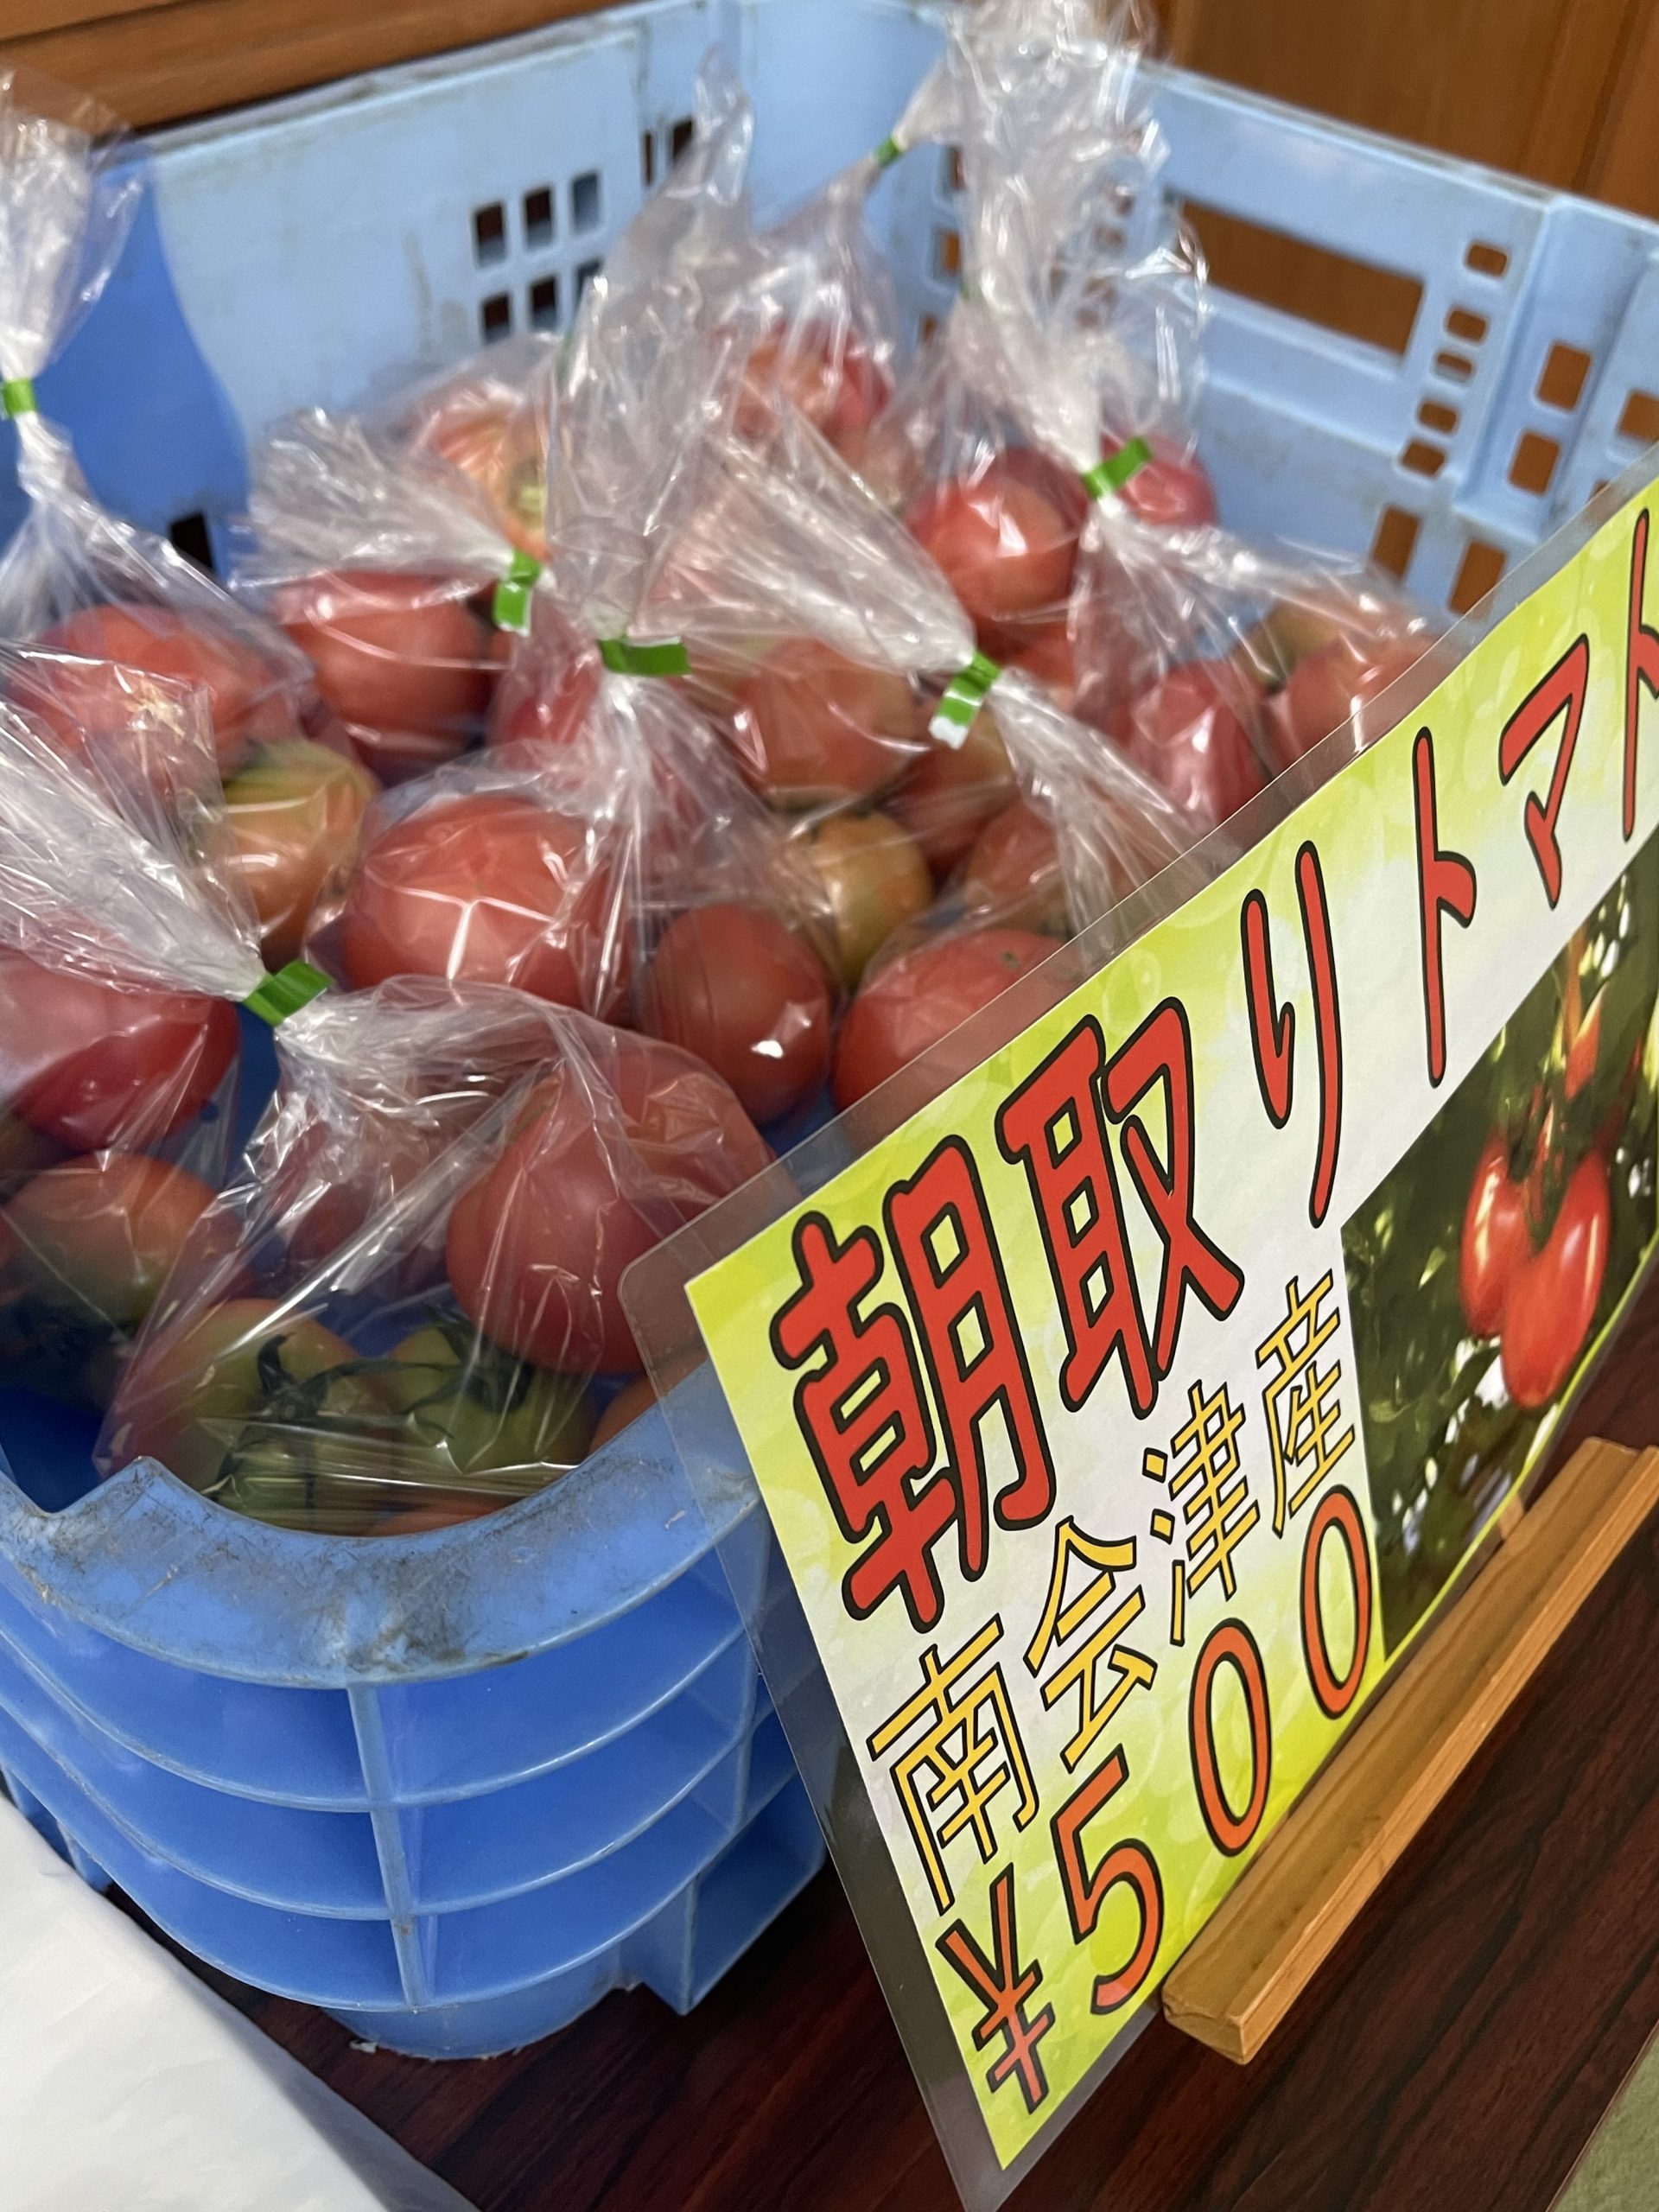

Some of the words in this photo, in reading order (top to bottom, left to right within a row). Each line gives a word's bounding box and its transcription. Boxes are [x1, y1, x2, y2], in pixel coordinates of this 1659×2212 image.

[770, 508, 1659, 1632] 朝取りトマト
[866, 1269, 1355, 1916] 南会津産
[936, 1484, 1372, 2114] ¥500
